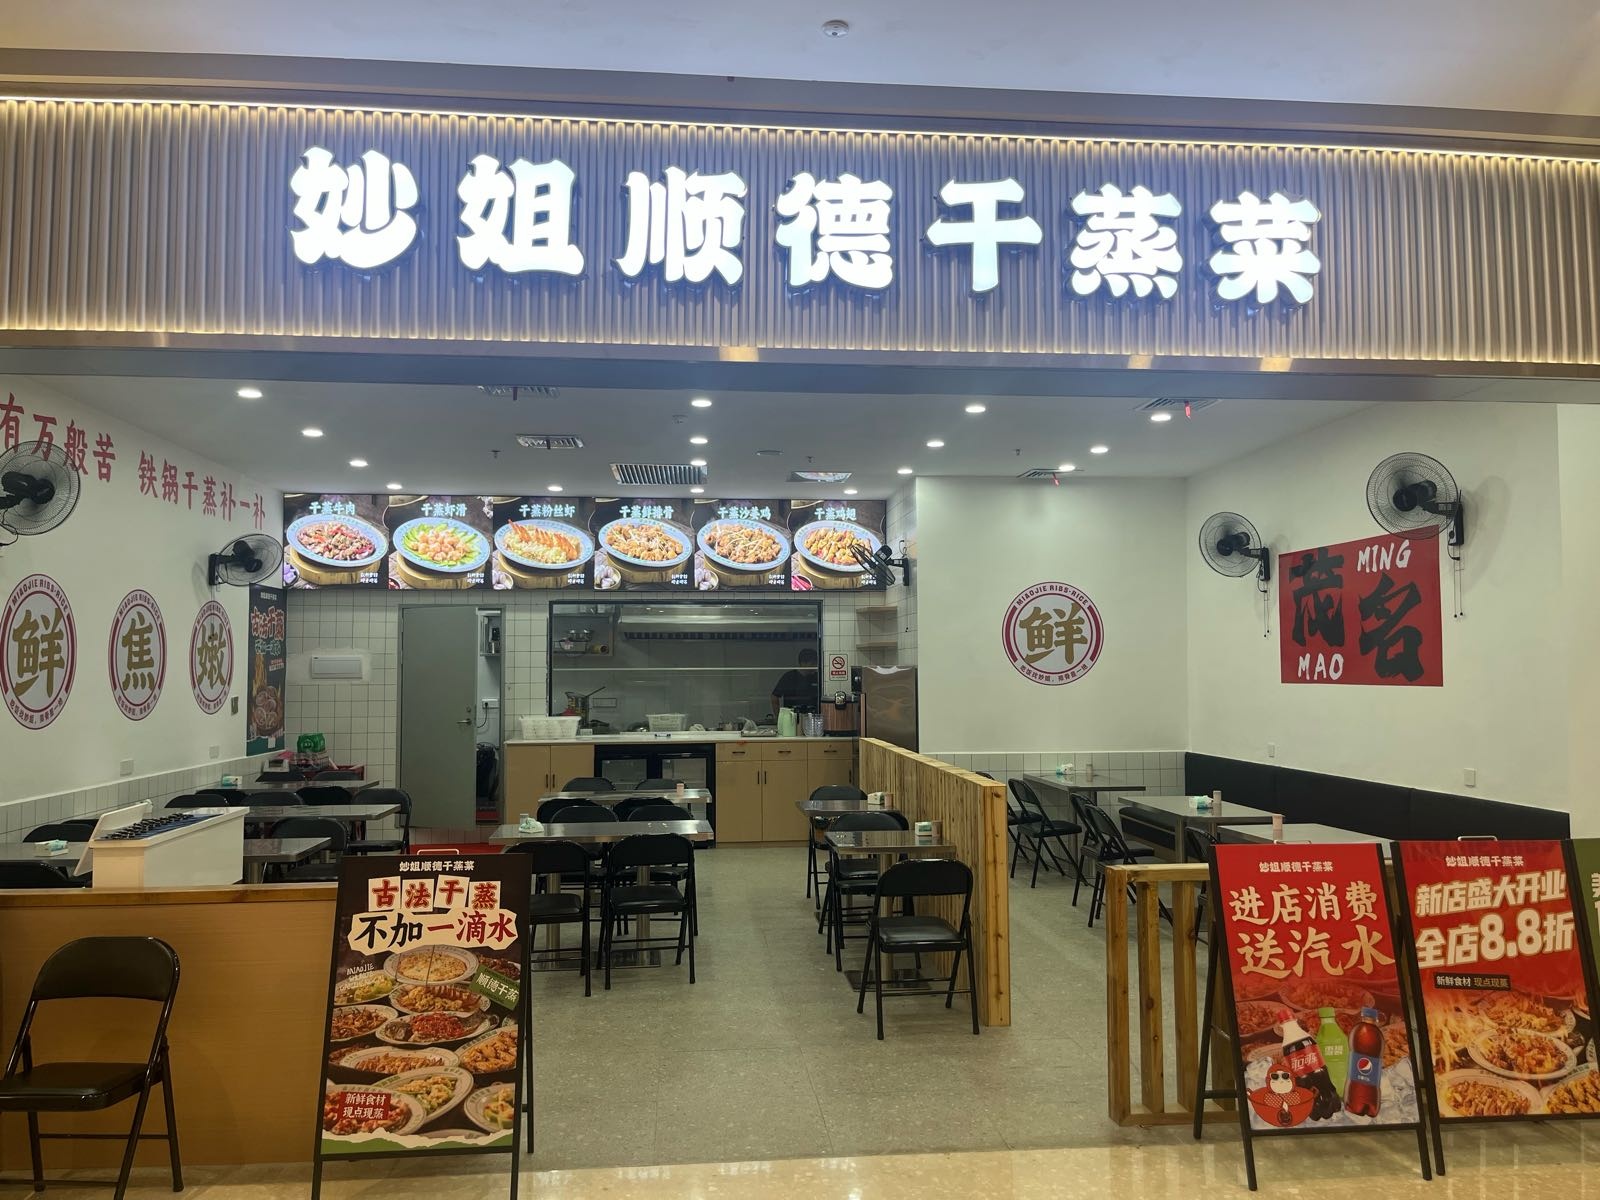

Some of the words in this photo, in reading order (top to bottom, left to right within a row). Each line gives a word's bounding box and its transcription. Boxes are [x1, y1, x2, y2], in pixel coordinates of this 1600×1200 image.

[290, 147, 1322, 305] 妙姐顺德干蒸菜
[138, 449, 266, 531] 铁锅干蒸补一补
[309, 501, 355, 515] 干蒸牛肉
[421, 503, 467, 517] 干蒸虾滑
[519, 504, 575, 518] 干蒸粉丝虾
[619, 505, 674, 519] 干蒸鲜排骨
[1357, 539, 1412, 573] MING
[1016, 585, 1047, 607] MIAOJIE
[1019, 602, 1088, 665] 鲜
[12, 608, 65, 698] 鲜
[122, 611, 155, 691] 焦
[197, 623, 227, 690] 嫩
[1298, 652, 1344, 681] MAO
[399, 861, 475, 872] 妙姐顺德干蒸菜
[1259, 861, 1333, 873] 妙姐顺德干蒸菜
[1445, 856, 1525, 867] 妙姐顺德干蒸菜
[372, 879, 498, 910] 古法干蒸
[1229, 880, 1378, 926] 进店消费
[1416, 868, 1567, 917] 新店盛大开业
[354, 910, 517, 949] 不加一滴水
[1415, 908, 1575, 969] 全店8.8折
[1236, 924, 1396, 979] 送汽水
[476, 972, 519, 1002] 顺德干蒸
[1436, 975, 1471, 987] 新鲜食材
[342, 1107, 385, 1119] 现点现蒸
[345, 1093, 387, 1106] 新鲜食材
